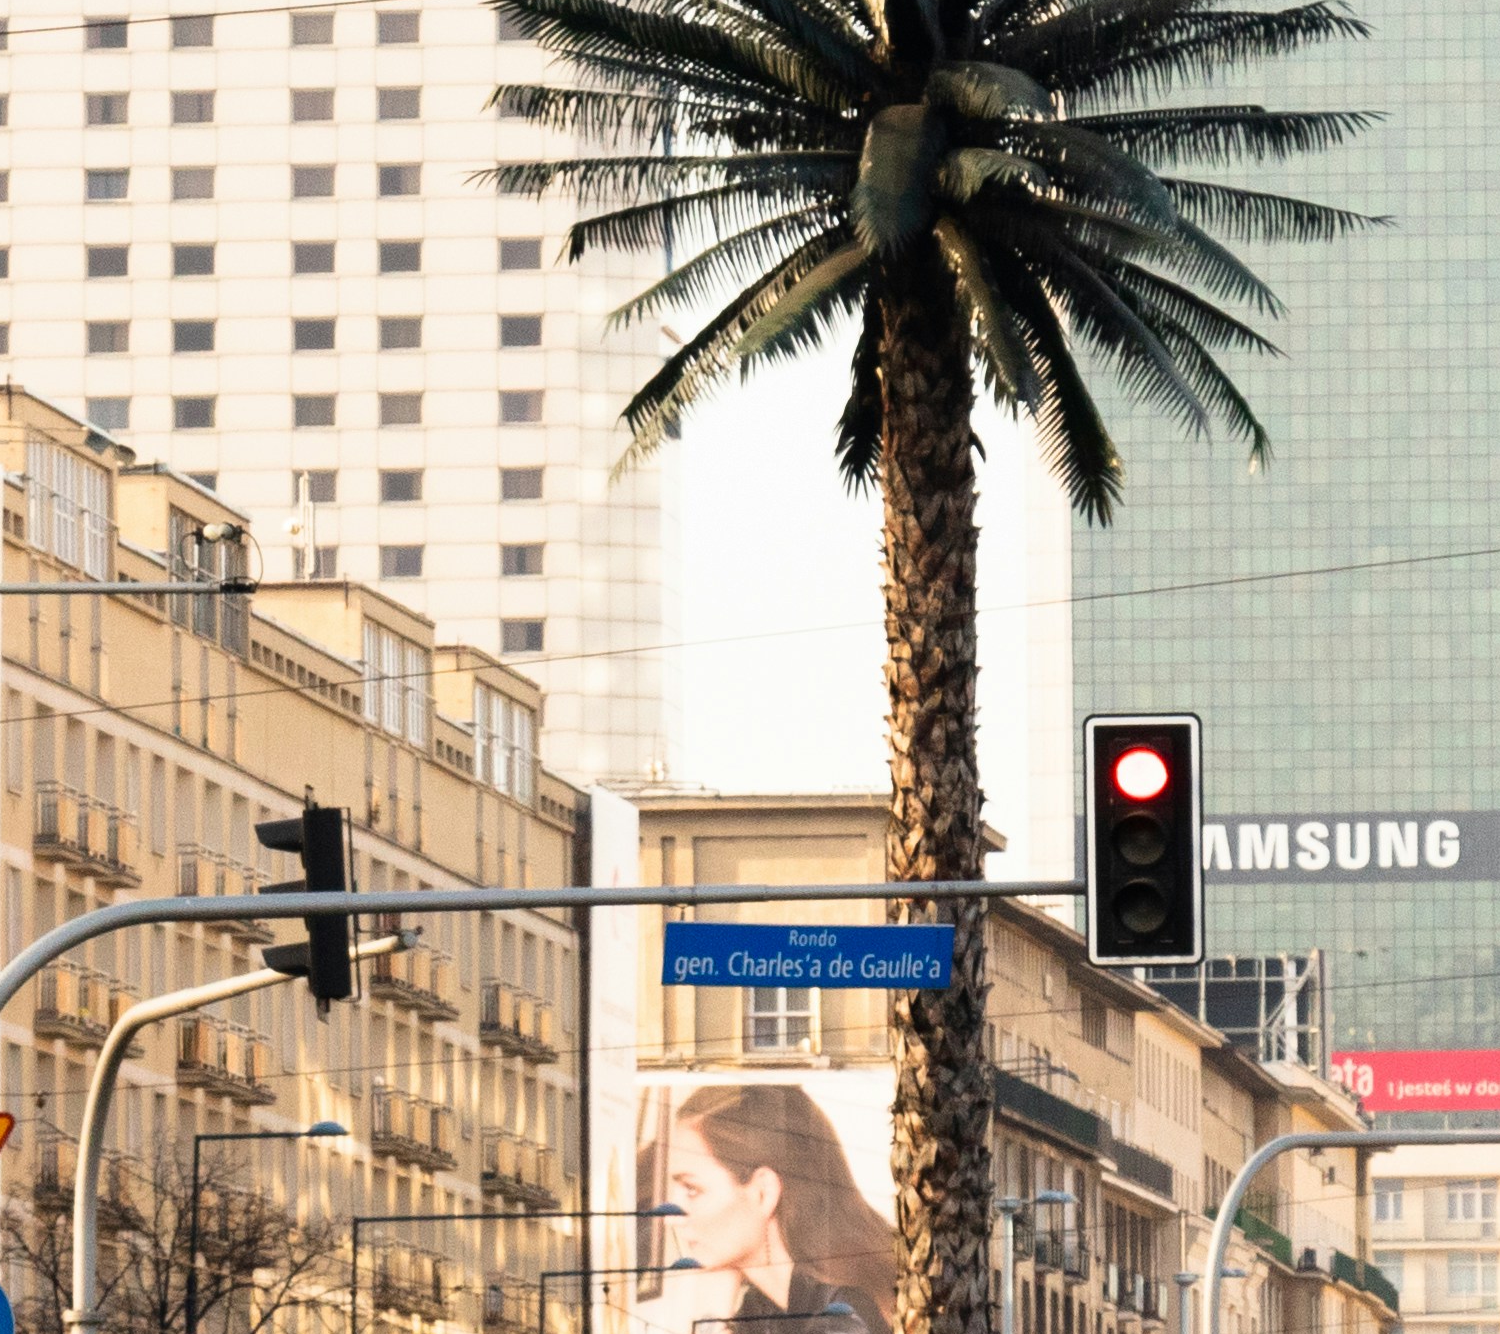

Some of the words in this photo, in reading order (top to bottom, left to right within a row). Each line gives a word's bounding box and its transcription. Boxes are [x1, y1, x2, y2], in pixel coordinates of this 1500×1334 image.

[1202, 820, 1461, 871] AMSUNG
[788, 929, 837, 947] Rondo
[674, 956, 719, 981] gen.
[728, 951, 822, 978] Charles'a
[829, 953, 854, 978] de
[860, 954, 941, 979] Gaulle'a
[1331, 1058, 1374, 1097] ata
[1397, 1079, 1452, 1100] jesteś
[1454, 1083, 1472, 1096] w
